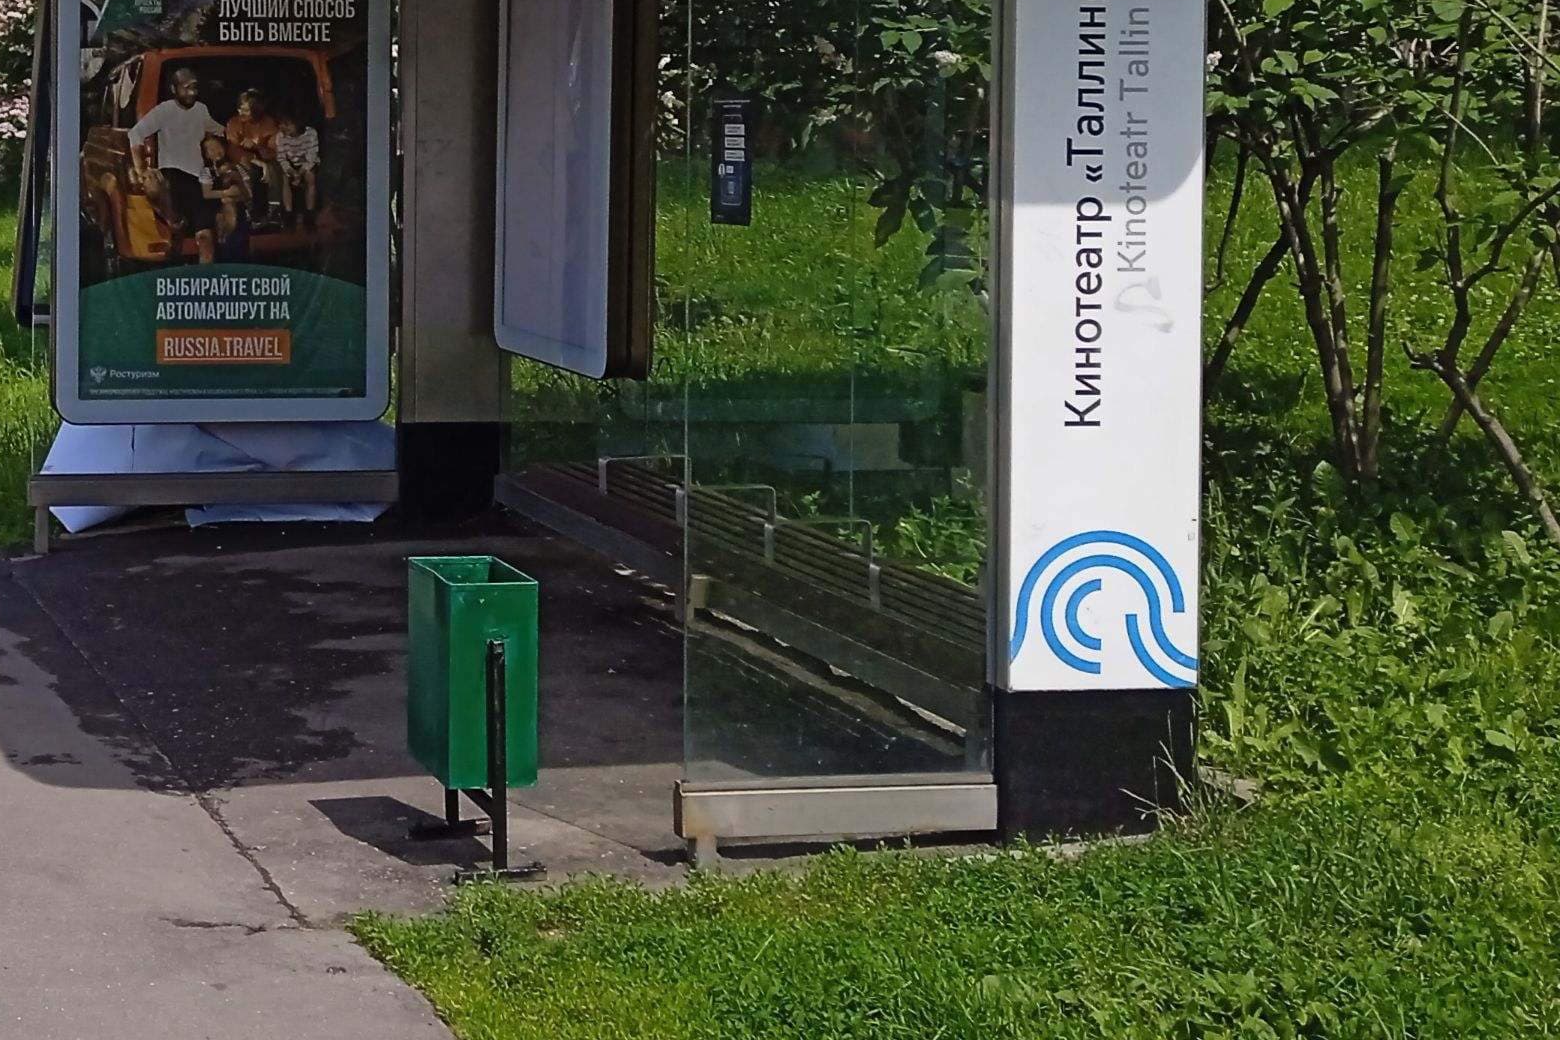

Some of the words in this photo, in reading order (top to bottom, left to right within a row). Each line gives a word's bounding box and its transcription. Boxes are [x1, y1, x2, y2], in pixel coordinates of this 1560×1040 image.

[219, 21, 264, 42] БЫТЬ
[268, 21, 331, 42] ВМЕСТЕ
[1118, 6, 1150, 100] Tallin
[1117, 114, 1148, 273] Kinoteatr
[156, 274, 248, 296] ВЫБИРАЙТЕ
[251, 274, 291, 296] СВОЙ
[156, 301, 267, 320] АВТОМАРШРУТ
[270, 301, 291, 320] НА
[1063, 196, 1112, 428] Кинотеатр
[164, 336, 283, 357] RUSSIA.TRAVEL
[109, 369, 160, 380] Ростуризм
